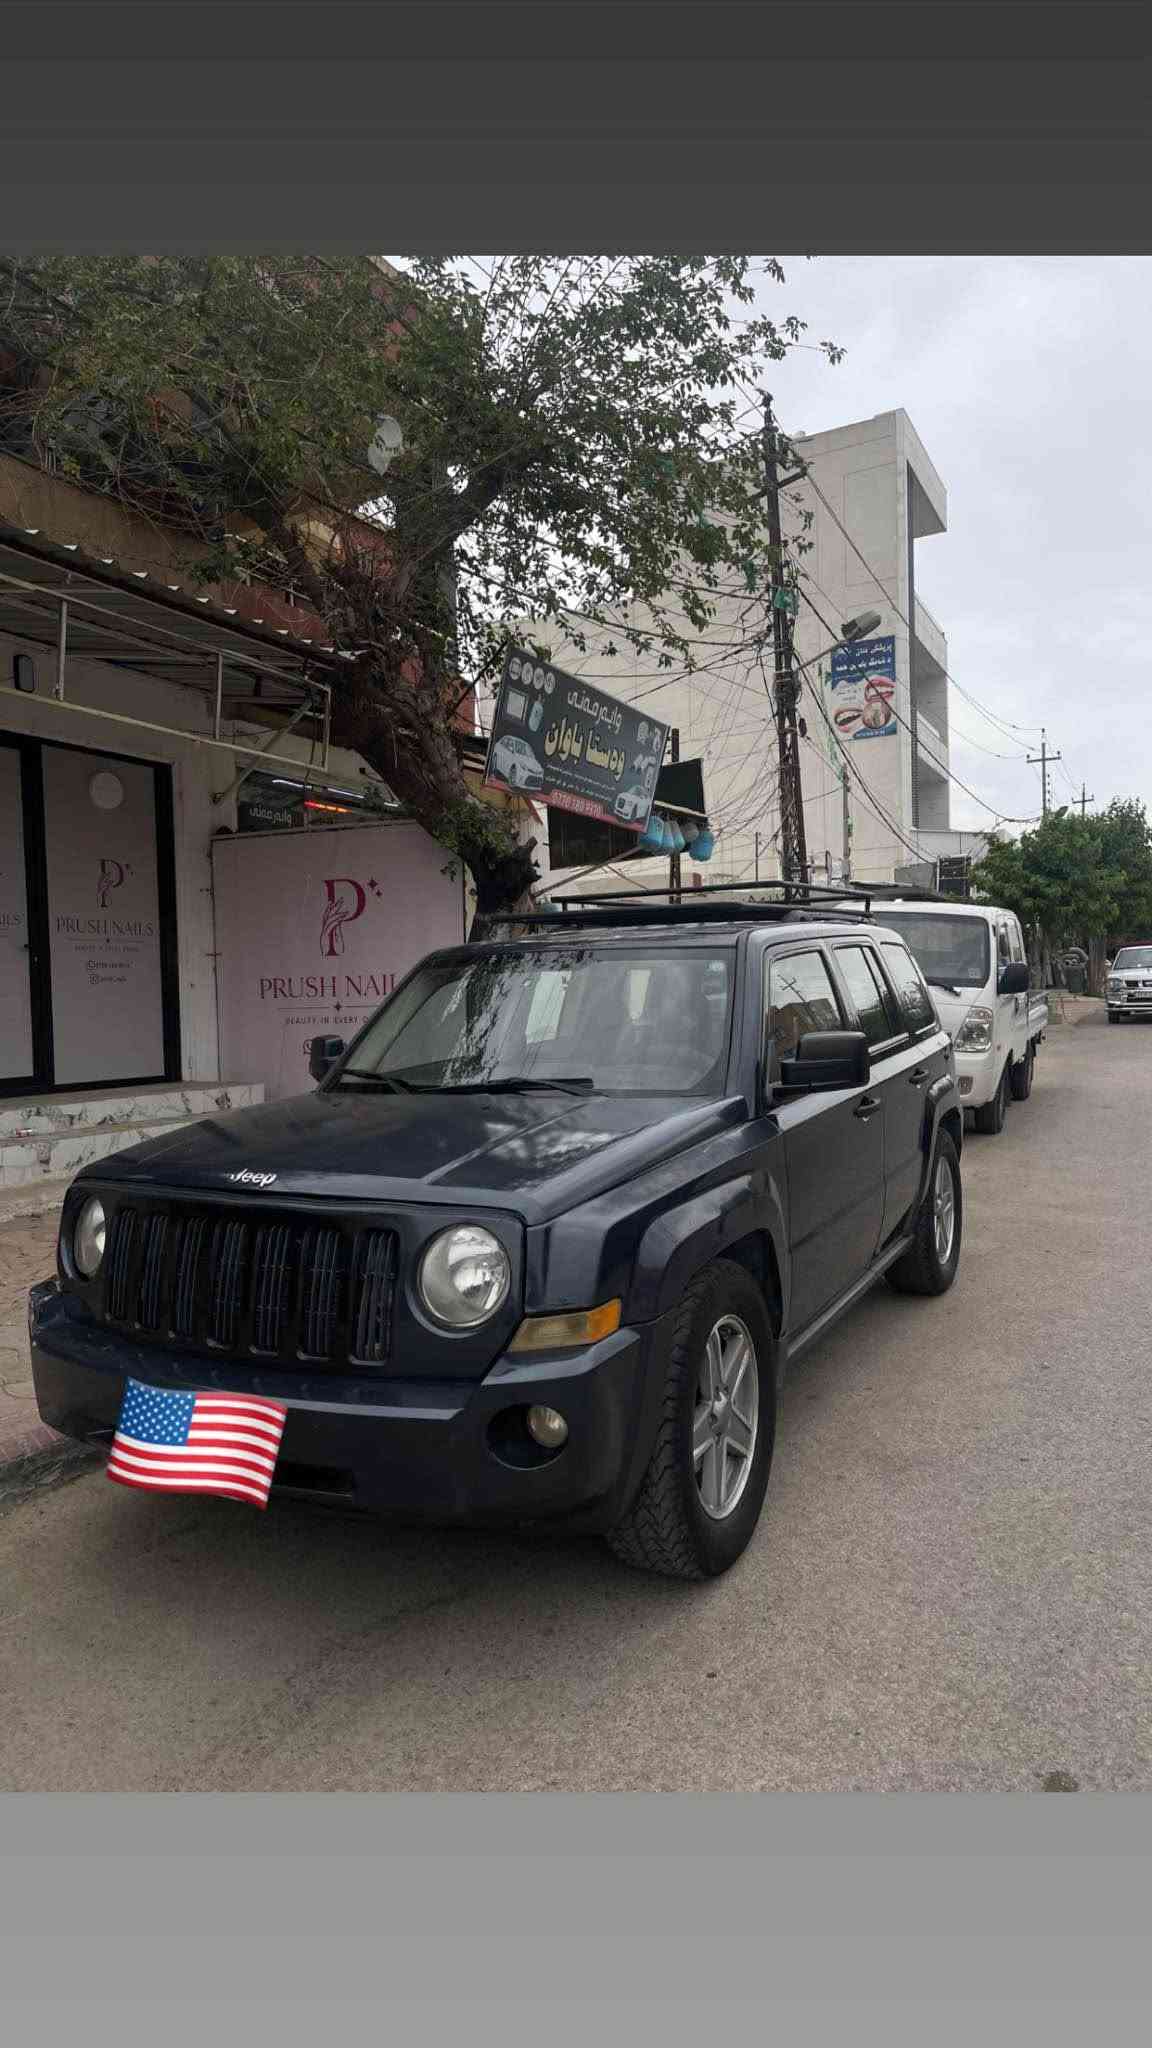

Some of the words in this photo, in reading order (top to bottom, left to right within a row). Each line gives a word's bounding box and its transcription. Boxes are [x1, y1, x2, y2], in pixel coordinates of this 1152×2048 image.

[544, 716, 584, 765] باوان
[585, 729, 626, 782] وەستا
[56, 914, 108, 937] PRUSH
[112, 919, 154, 937] NAILS
[322, 878, 366, 957] P
[260, 976, 337, 999] PRUSH
[345, 974, 395, 998] NAIL
[286, 1016, 318, 1025] BEAUTY
[320, 1016, 330, 1025] IN
[334, 1016, 358, 1025] EVERY
[229, 1168, 277, 1188] Jeep
